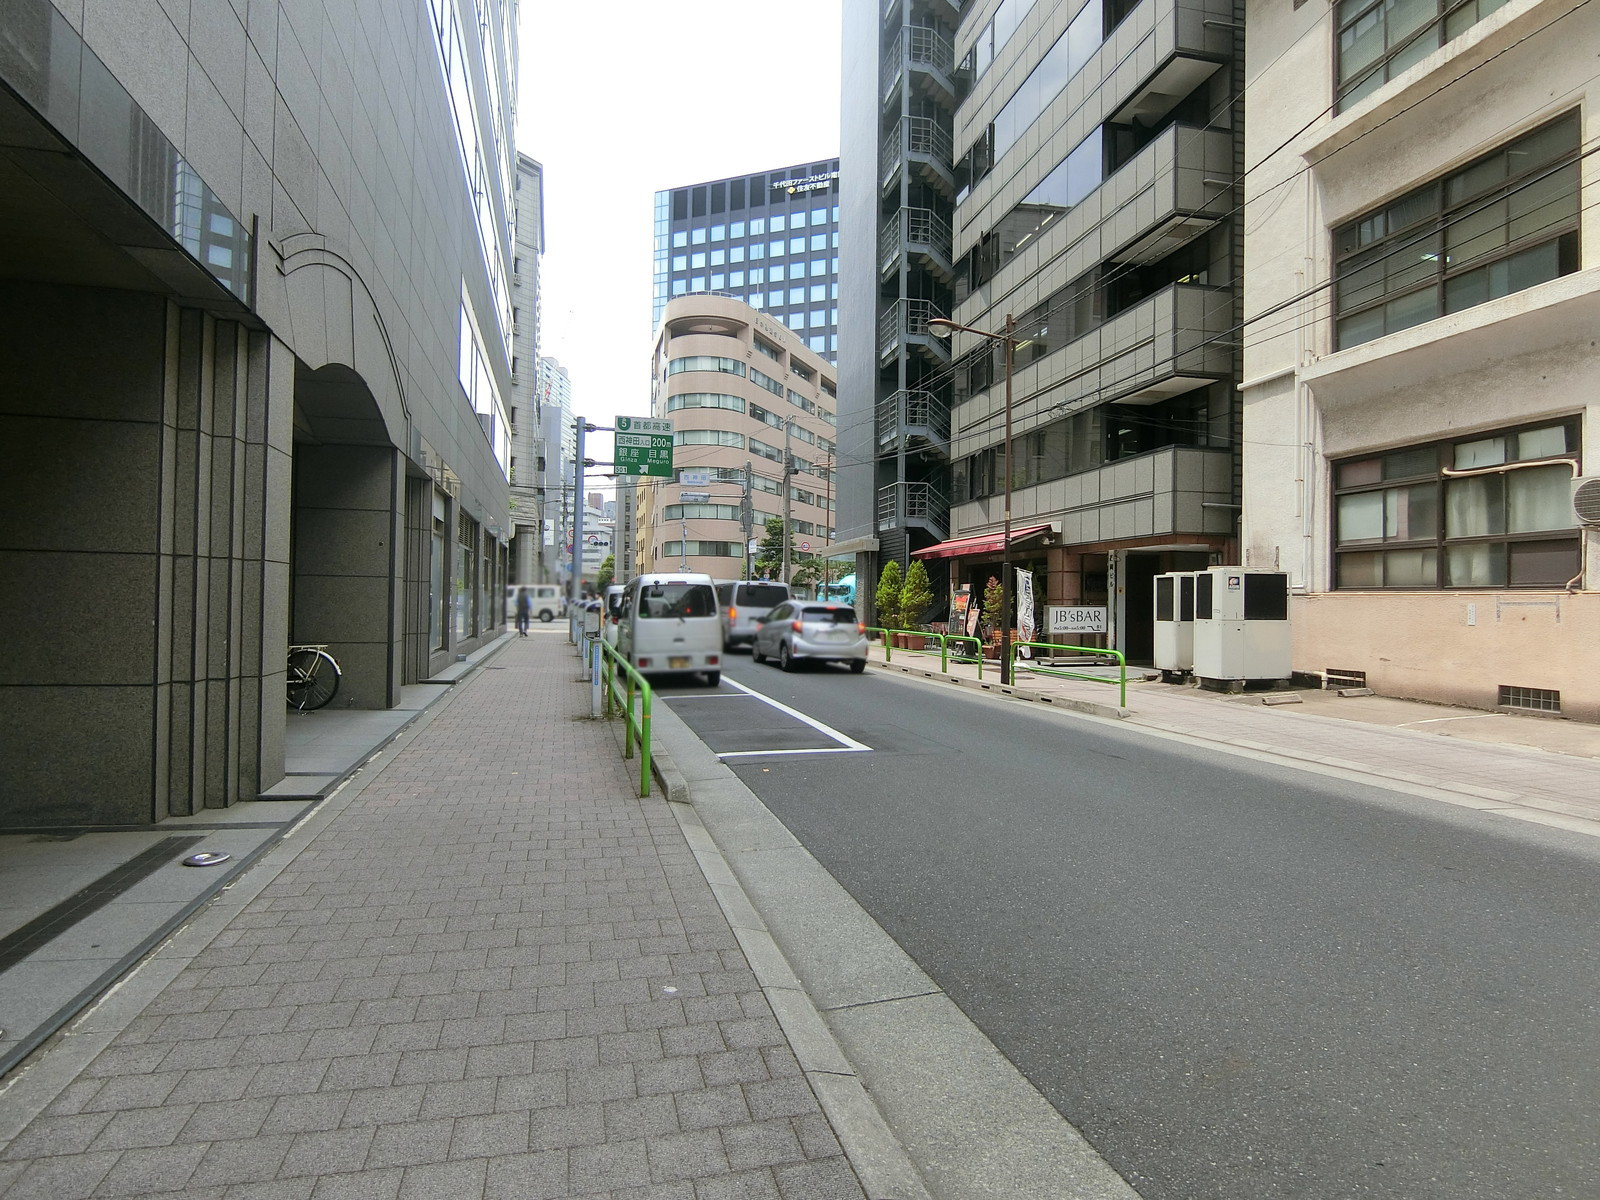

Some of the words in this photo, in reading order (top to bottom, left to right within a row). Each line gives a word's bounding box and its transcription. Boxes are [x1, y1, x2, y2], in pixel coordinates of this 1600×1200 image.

[621, 418, 627, 428] 5
[633, 421, 671, 432] 首都高速
[618, 435, 650, 447] 西神田入口
[652, 438, 672, 448] 200m
[618, 448, 640, 457] 銀座
[649, 449, 669, 459] 目黒
